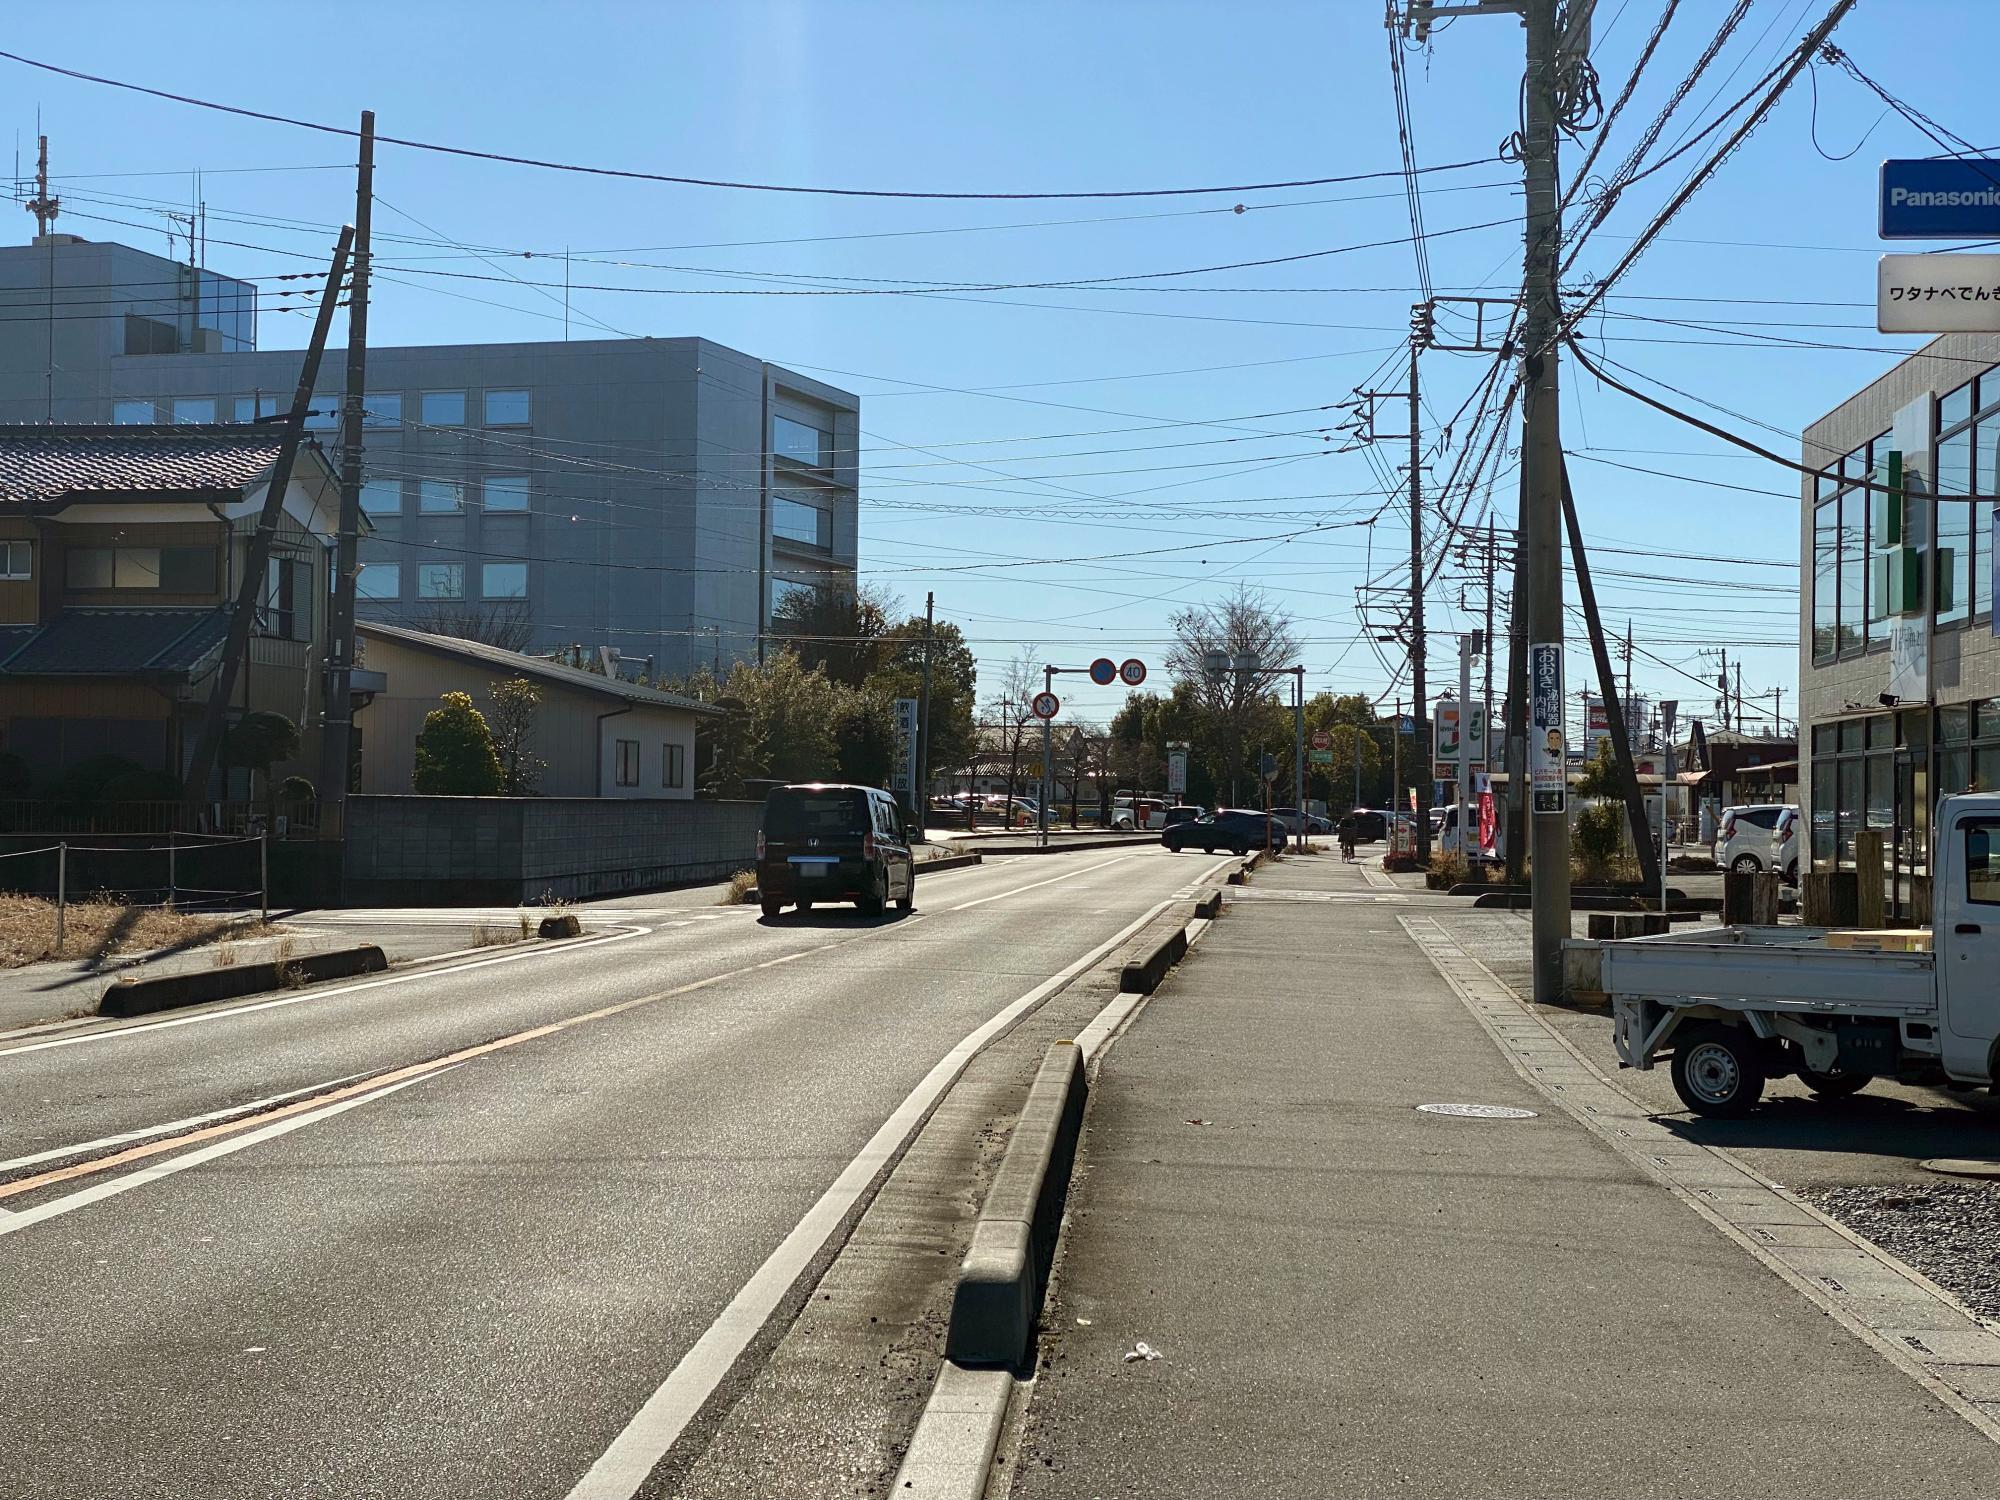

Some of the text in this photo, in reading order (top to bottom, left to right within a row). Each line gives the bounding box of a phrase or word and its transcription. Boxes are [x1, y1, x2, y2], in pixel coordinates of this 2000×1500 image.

[1891, 187, 2000, 206] Panasonic
[1126, 667, 1140, 678] 40
[1535, 695, 1547, 719] 内科
[1546, 688, 1559, 725] 泌尿器
